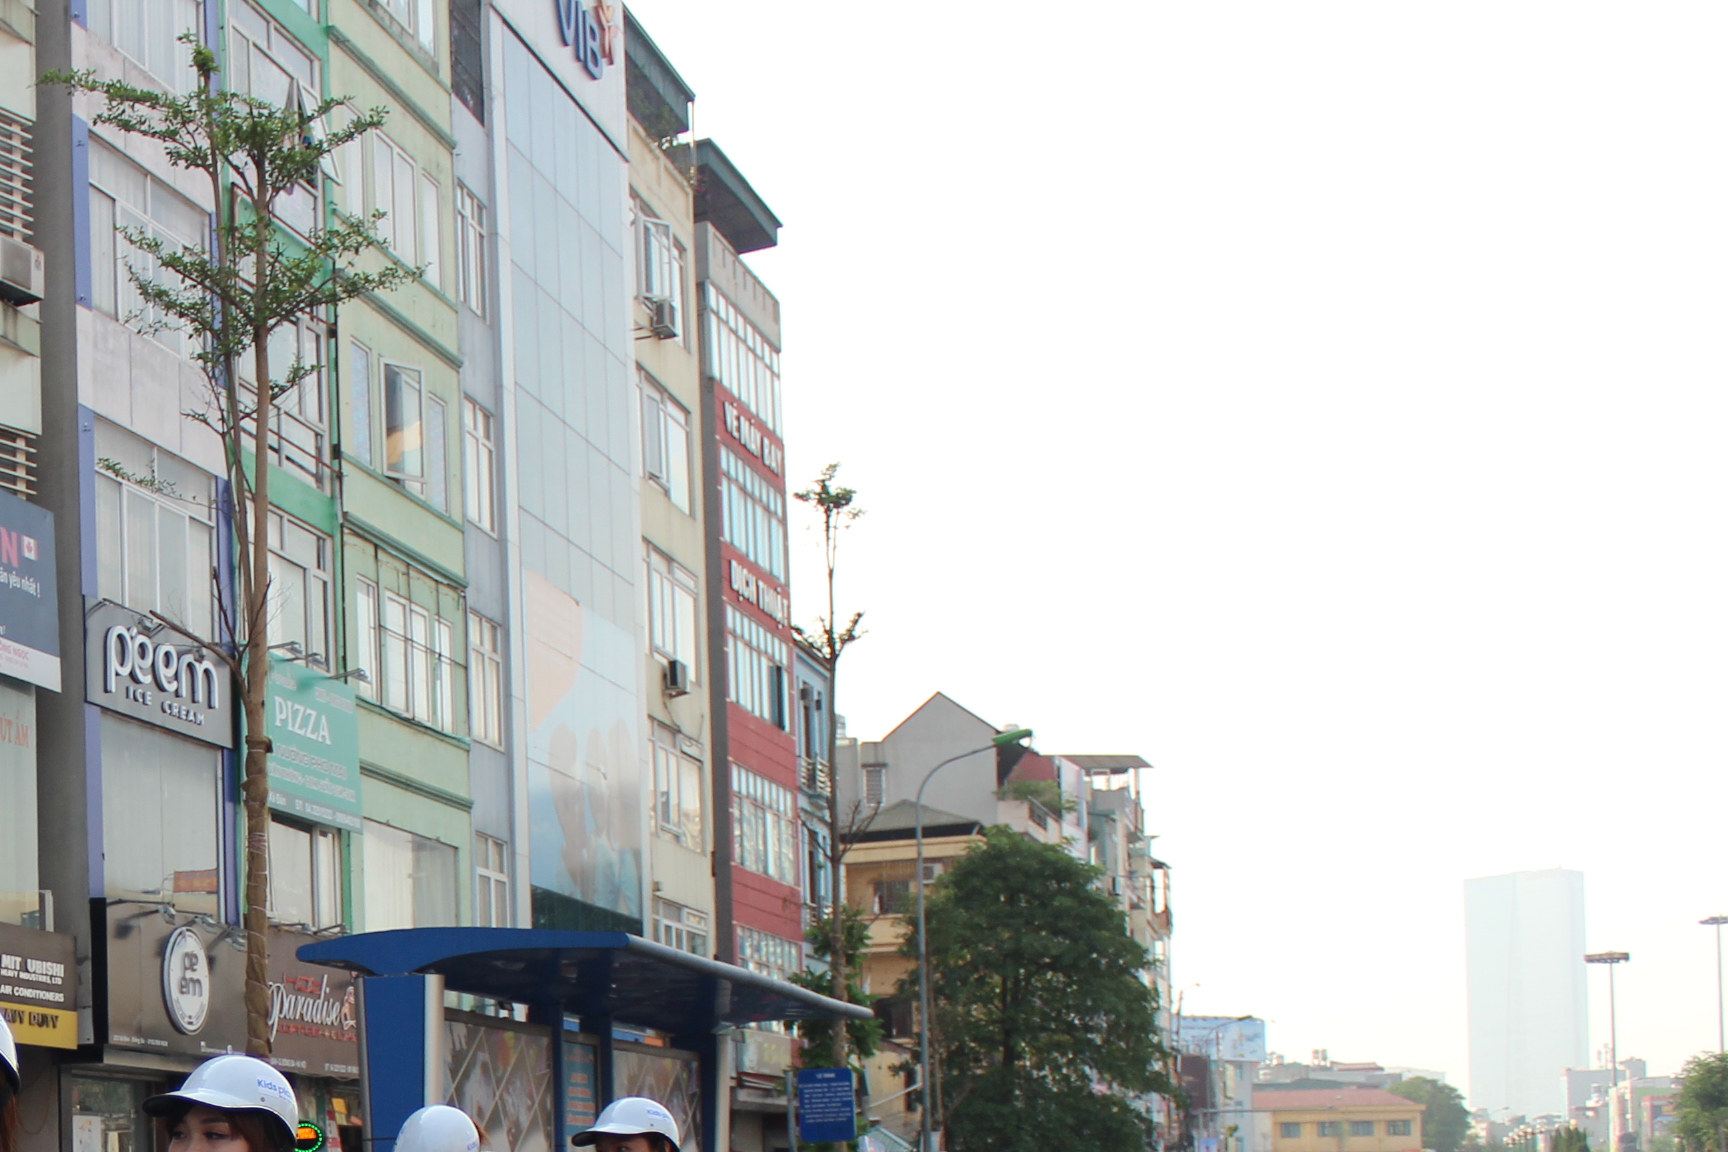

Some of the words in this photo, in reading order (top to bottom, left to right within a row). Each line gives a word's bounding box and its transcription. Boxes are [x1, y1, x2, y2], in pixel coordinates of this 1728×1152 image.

[126, 686, 152, 706] ICE
[161, 700, 205, 726] CREAM
[274, 696, 332, 746] PIZZA
[0, 985, 13, 995] AIR
[14, 986, 65, 1002] CONDITIONERS
